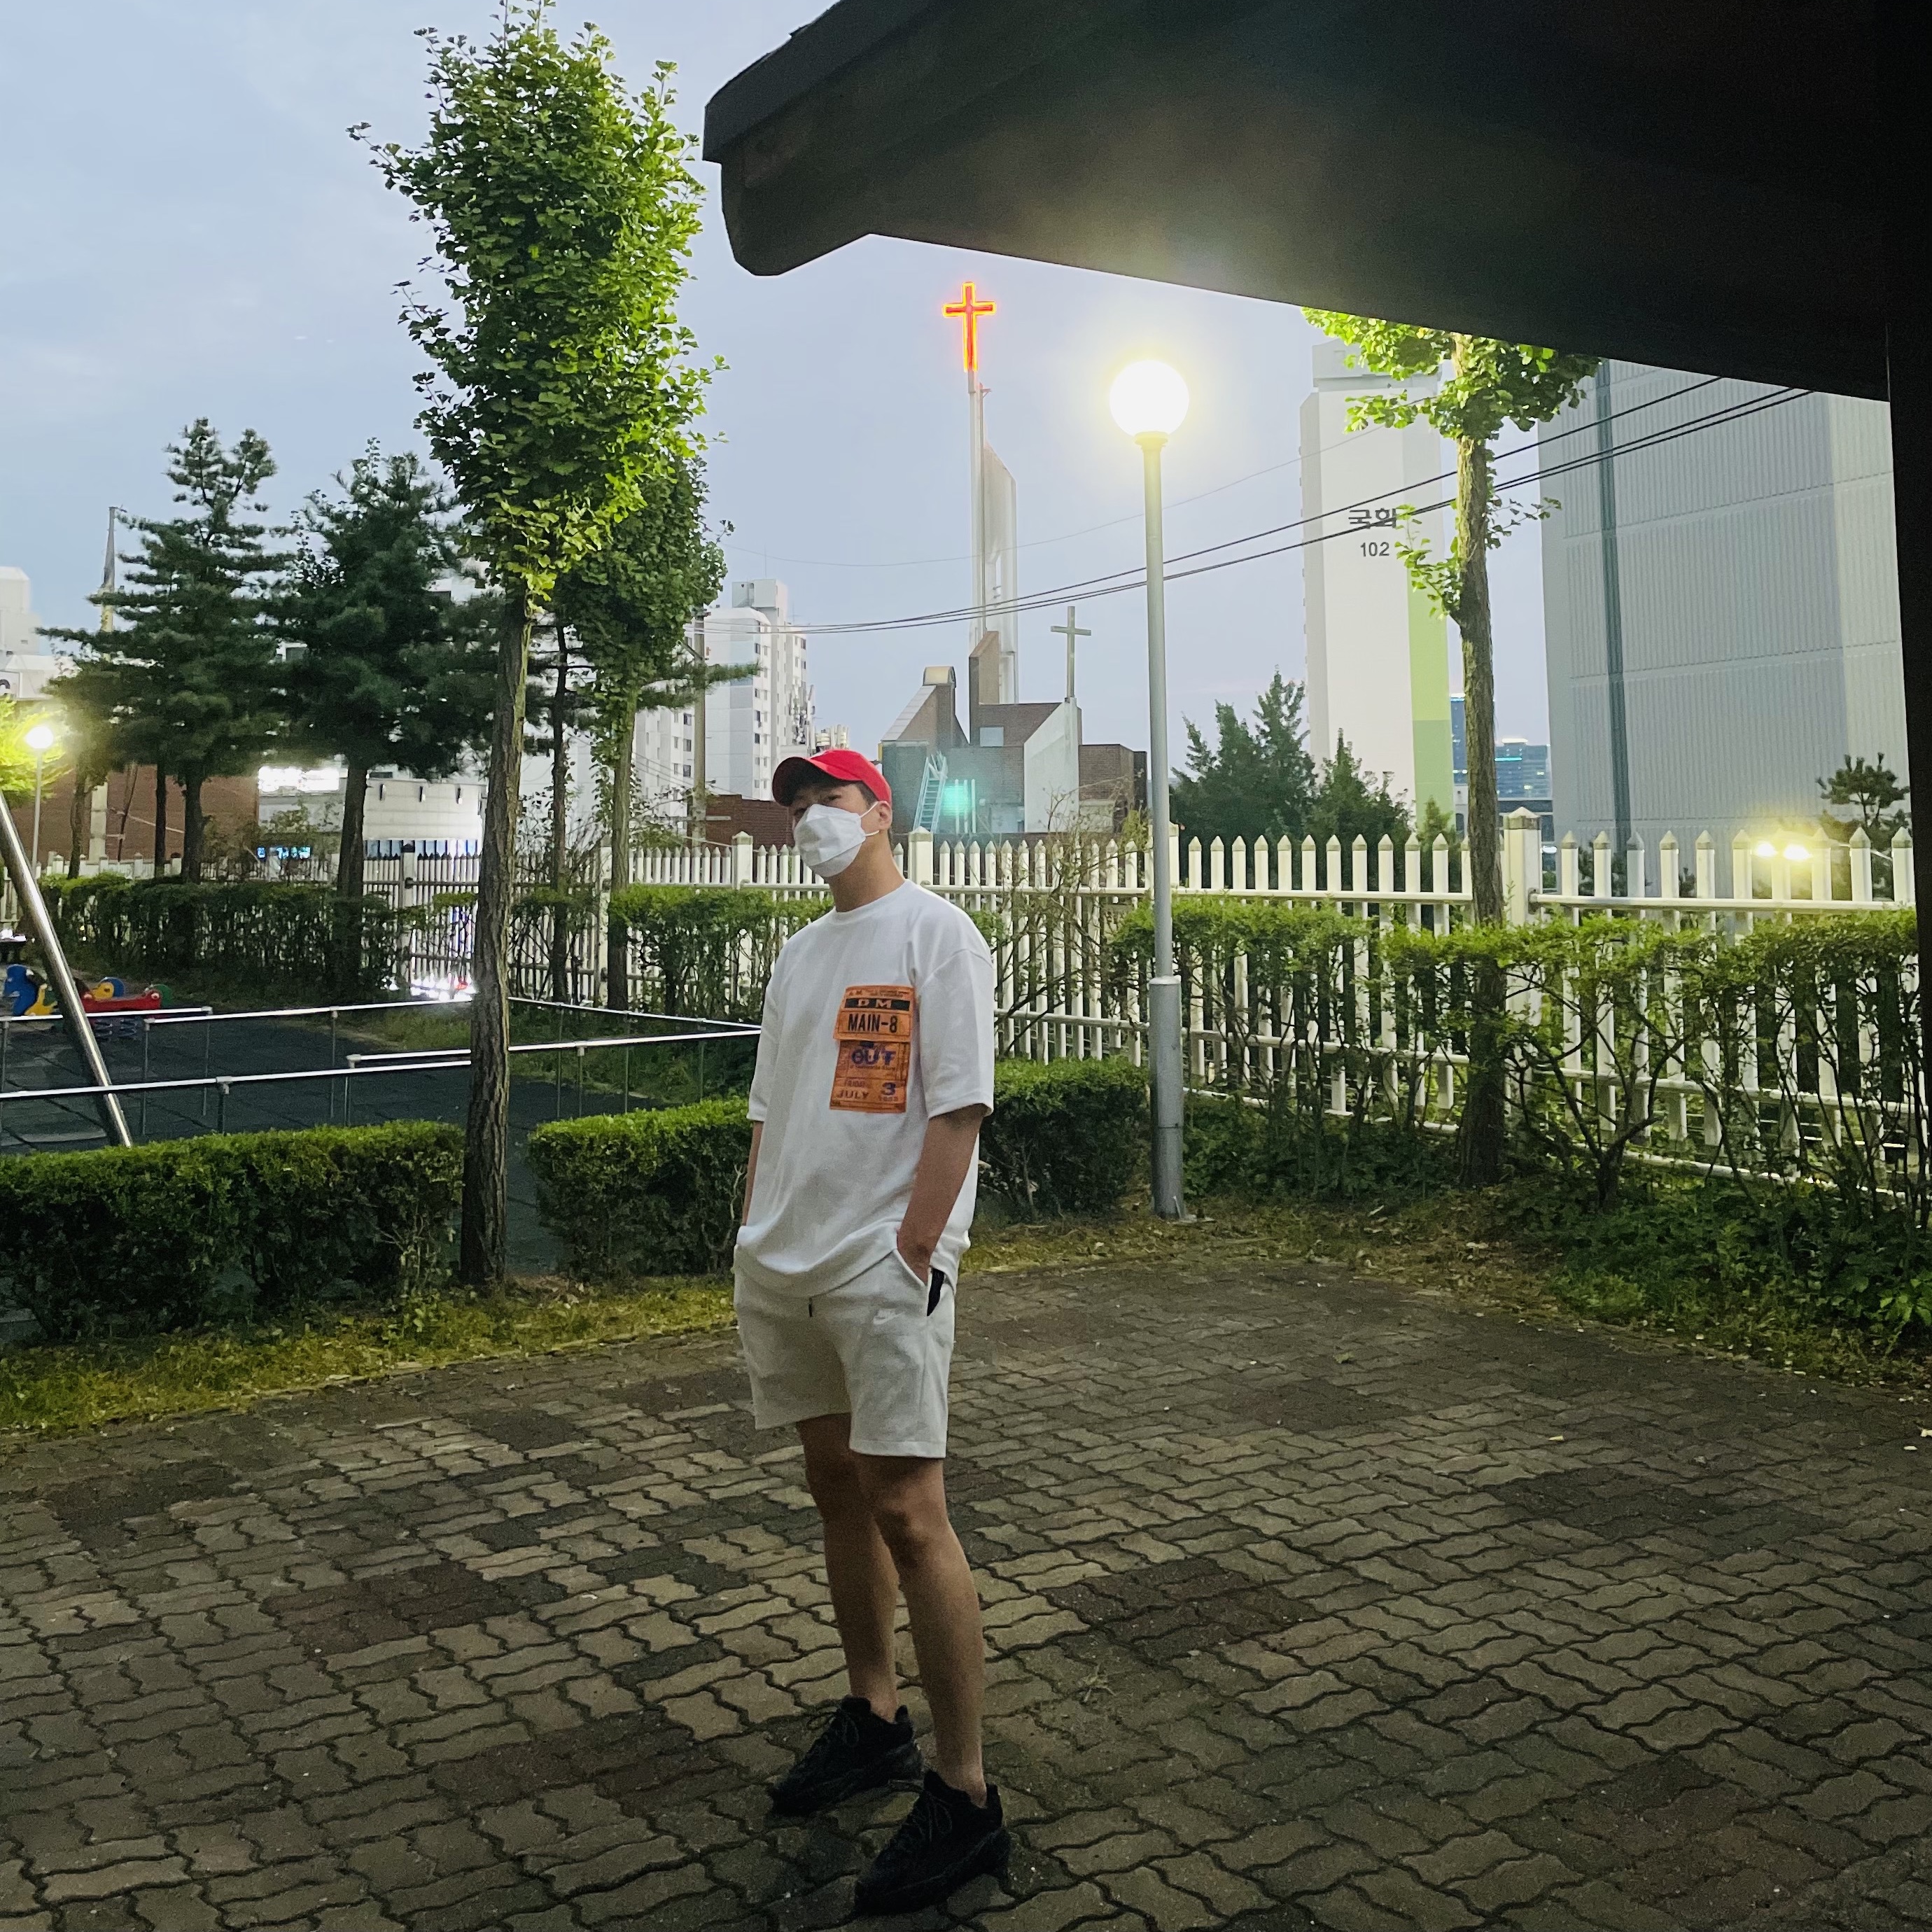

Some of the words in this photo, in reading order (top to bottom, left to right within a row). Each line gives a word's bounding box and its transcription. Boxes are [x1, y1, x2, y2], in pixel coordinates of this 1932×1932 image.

[1360, 542, 1390, 556] 102
[848, 1014, 898, 1033] MAIN-8
[837, 1090, 869, 1099] JULY
[880, 1082, 896, 1096] 3
